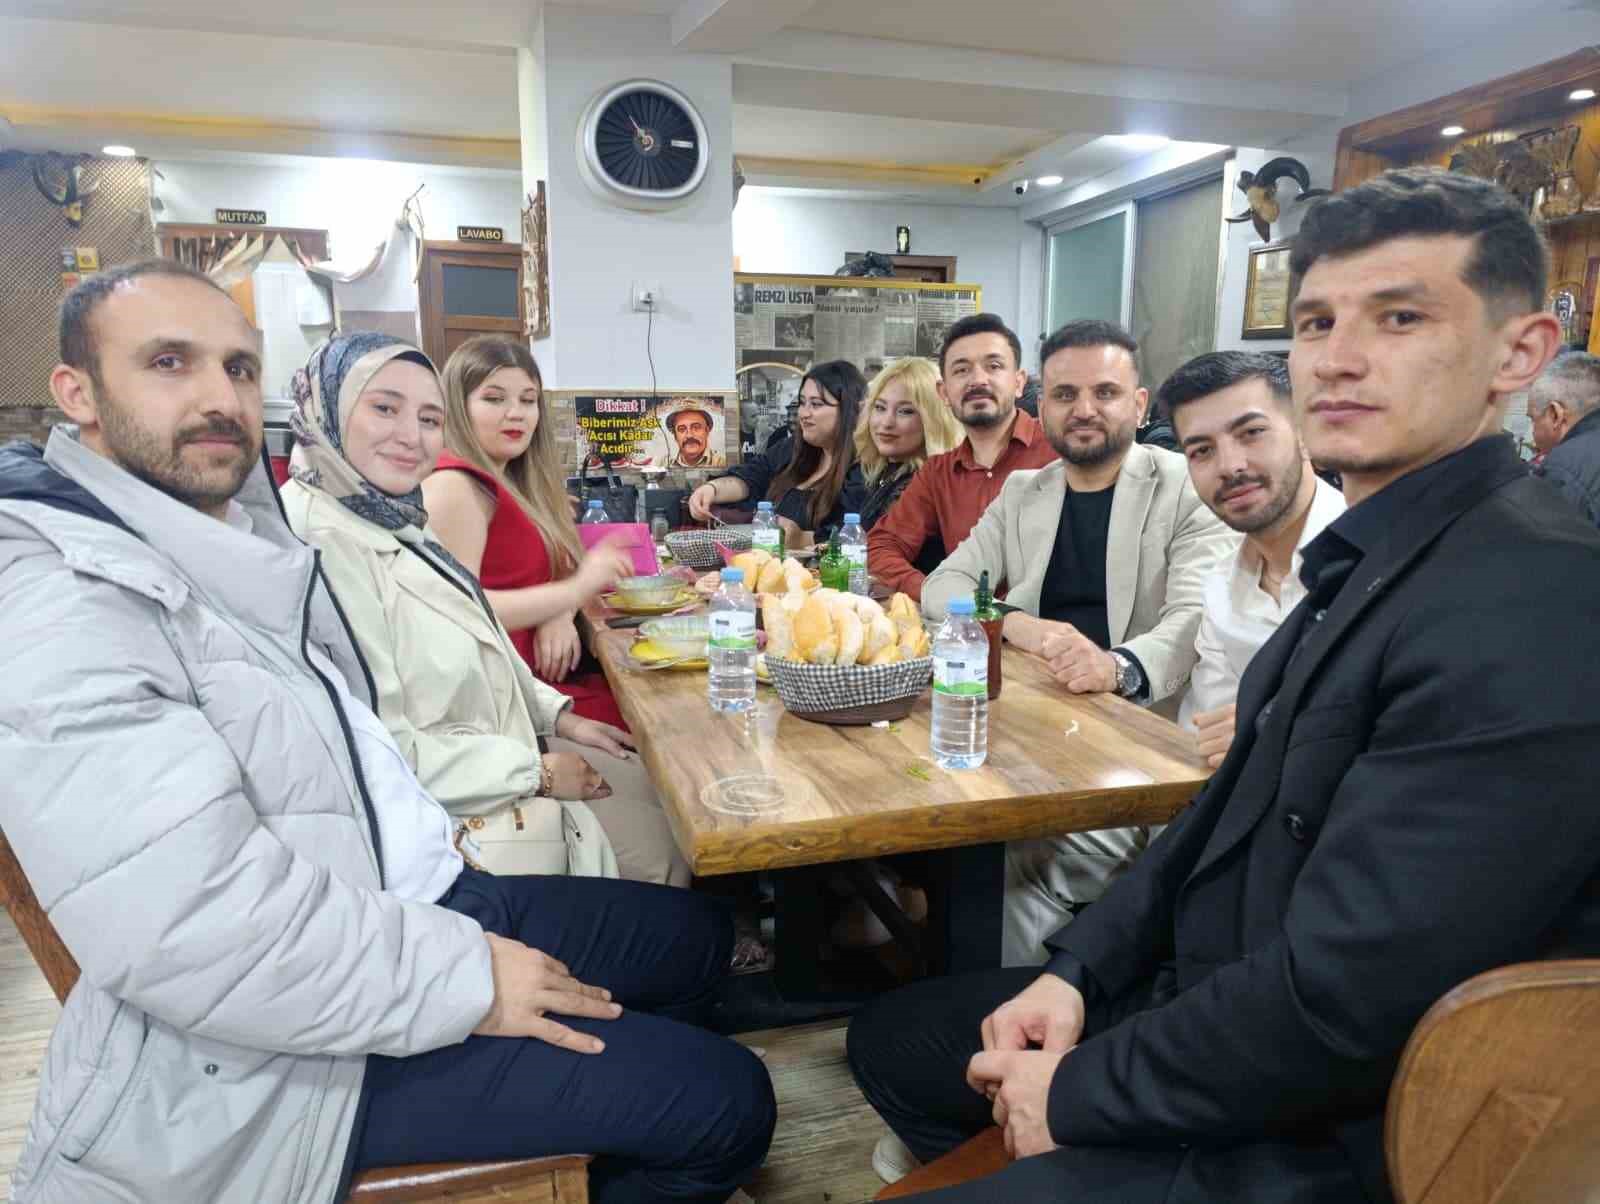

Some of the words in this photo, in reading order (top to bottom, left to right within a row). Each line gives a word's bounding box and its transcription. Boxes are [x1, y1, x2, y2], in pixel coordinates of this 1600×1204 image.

[217, 211, 265, 222] MUTFAK
[460, 229, 501, 239] LAVABO
[788, 291, 814, 304] USTA
[595, 399, 639, 412] Dikkat
[581, 416, 637, 428] Biberimiz
[620, 429, 655, 440] Kadar
